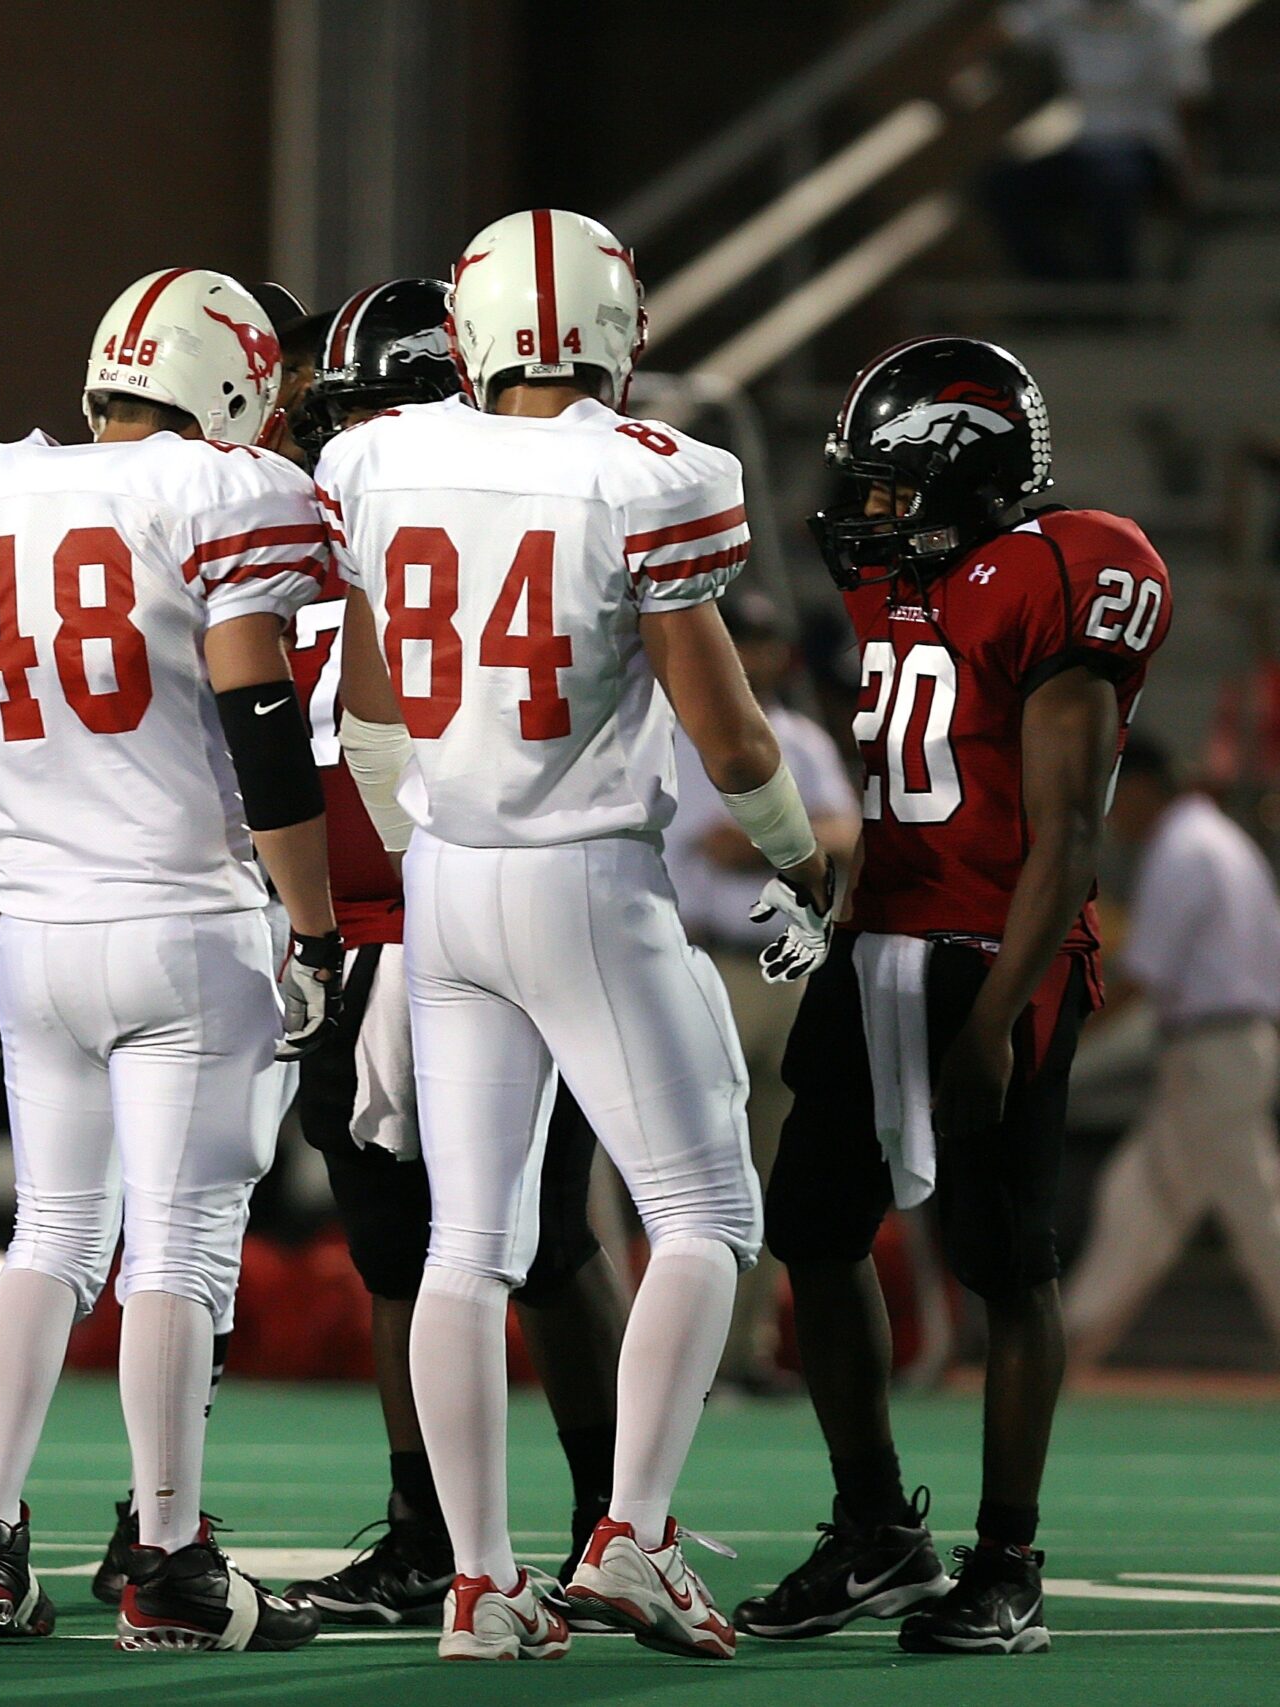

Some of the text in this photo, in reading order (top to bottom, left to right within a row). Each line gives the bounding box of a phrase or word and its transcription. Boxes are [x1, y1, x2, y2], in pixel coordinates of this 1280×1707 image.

[98, 367, 148, 388] Ridell
[516, 327, 582, 356] 8 4
[384, 526, 573, 741] 84
[1086, 568, 1162, 652] 20
[851, 641, 963, 823] 20
